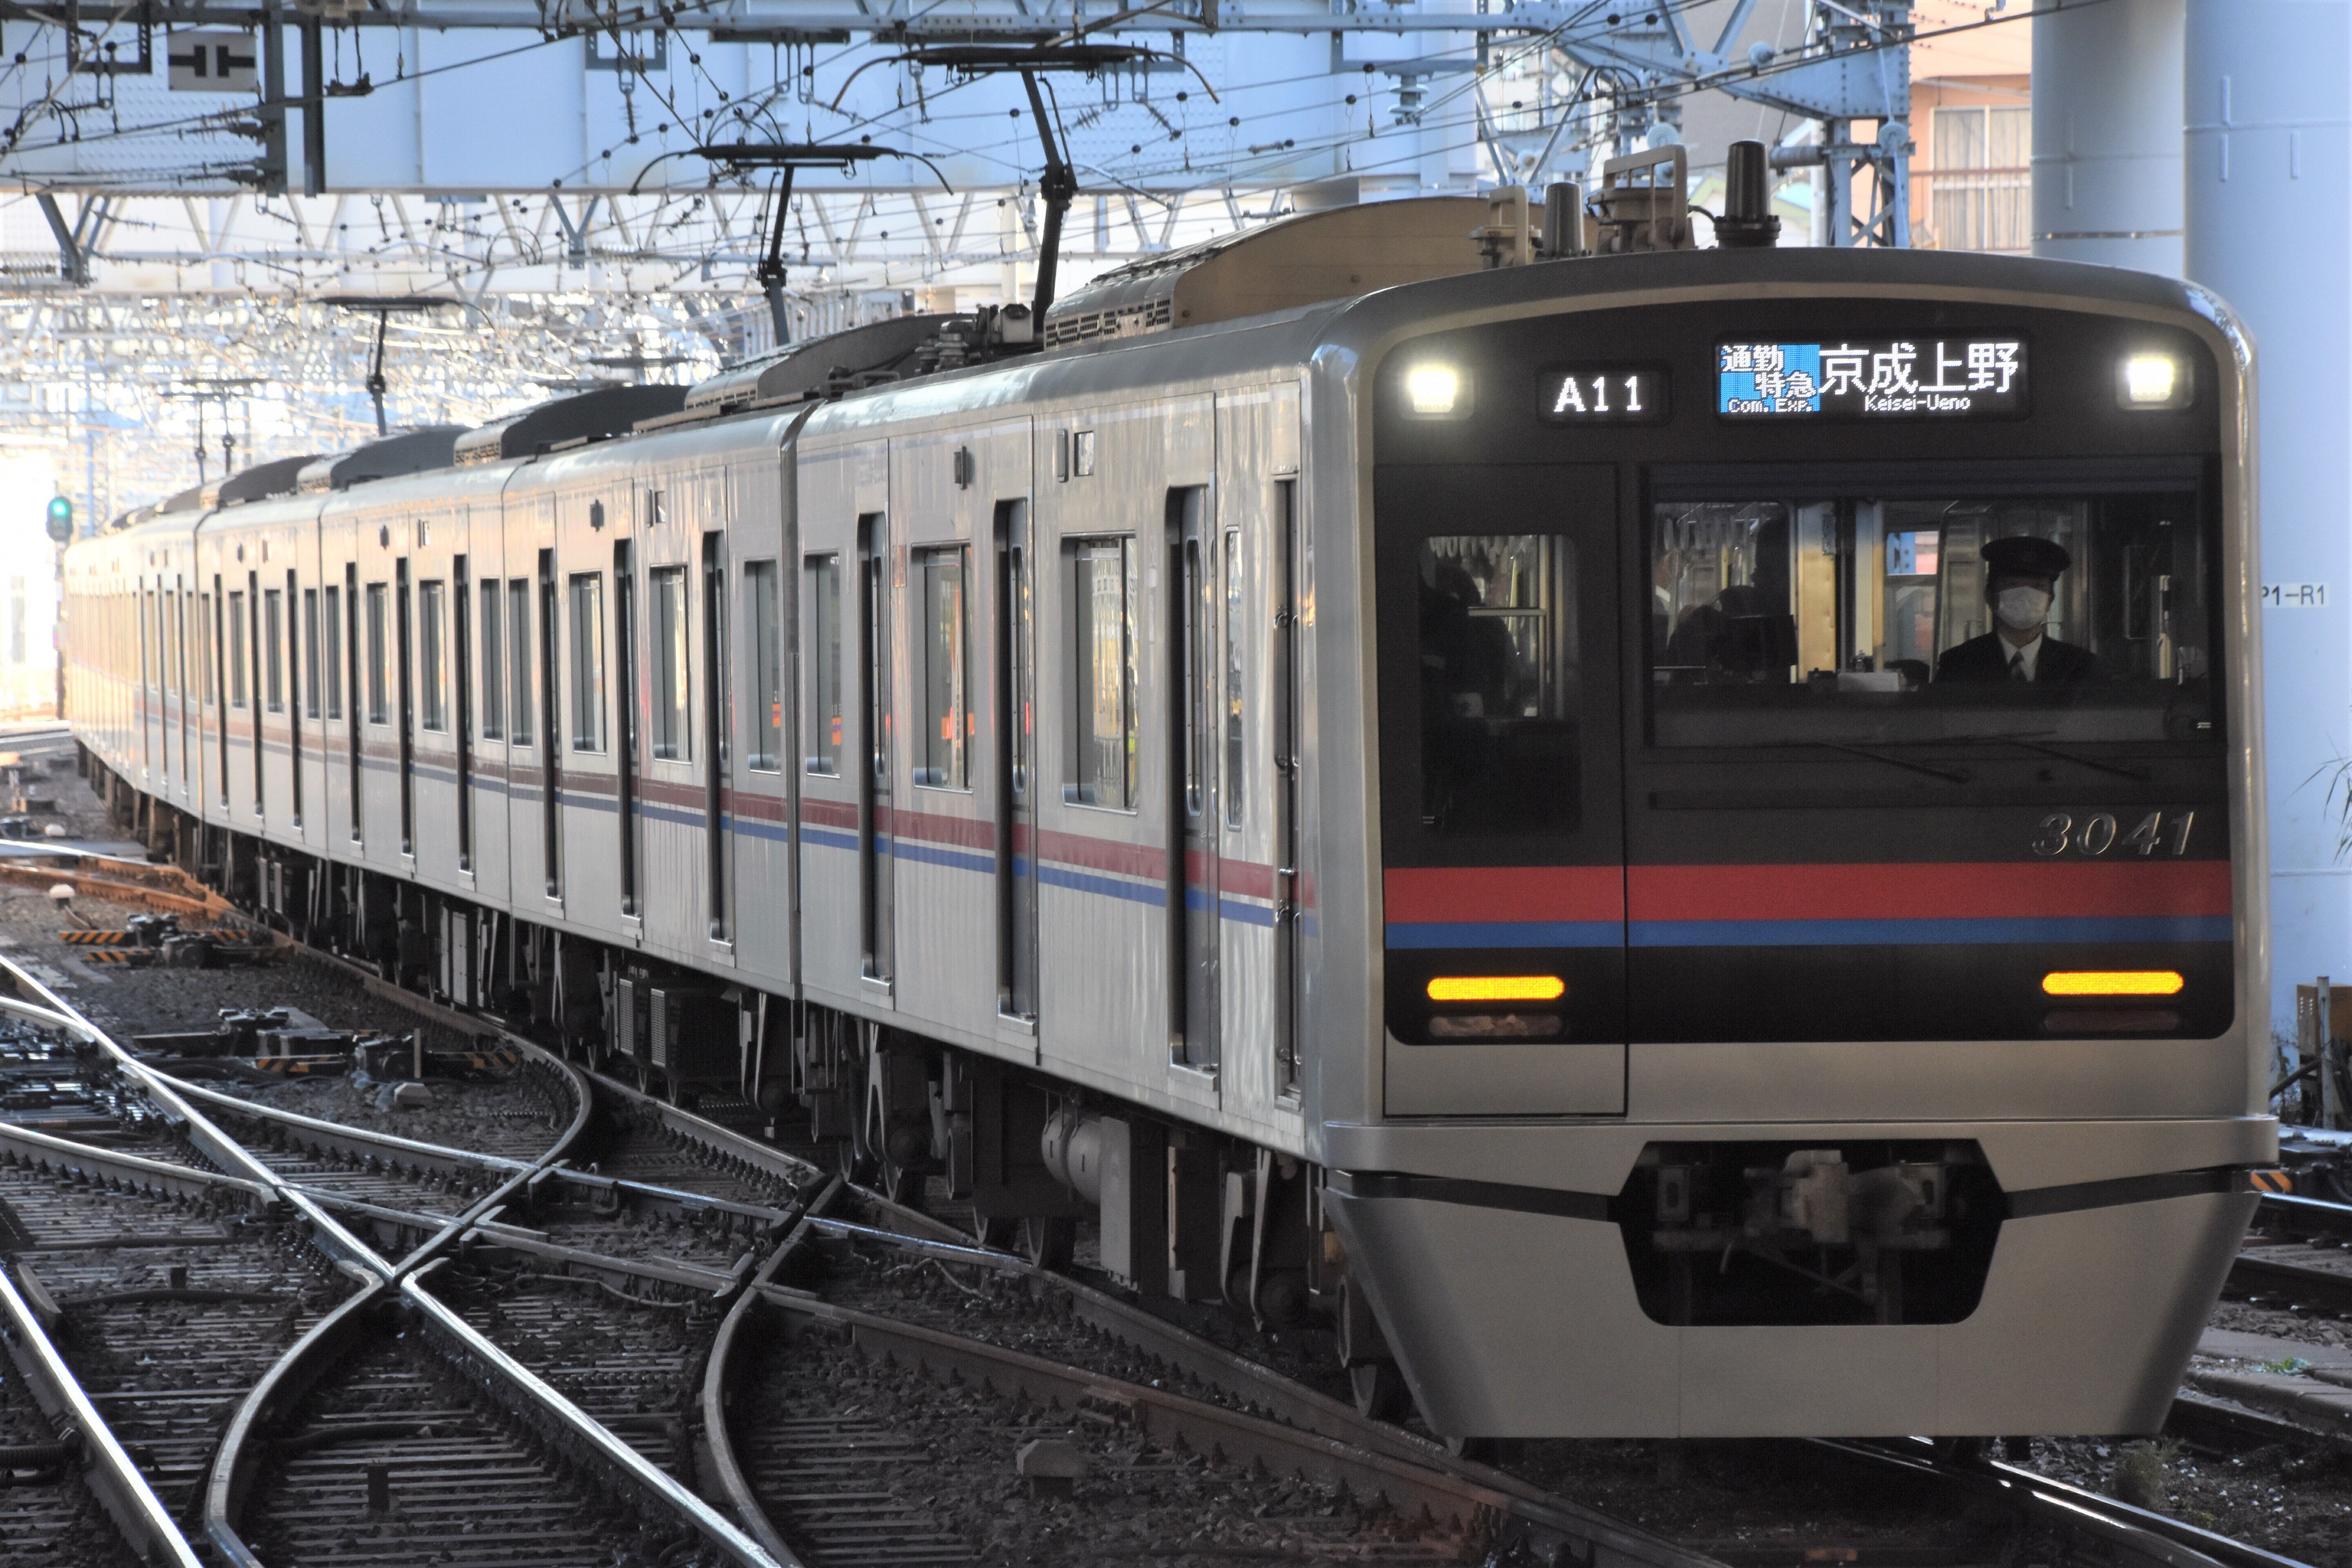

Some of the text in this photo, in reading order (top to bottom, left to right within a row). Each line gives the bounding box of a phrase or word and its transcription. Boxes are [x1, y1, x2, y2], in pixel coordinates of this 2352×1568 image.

[1722, 345, 1784, 372] 通勤
[1818, 342, 2019, 395] 京成上野
[1554, 375, 1641, 412] A11
[1755, 371, 1817, 398] 特急
[1728, 399, 1769, 413] Com.
[1864, 394, 1971, 412] Keisei-Ueno
[2032, 811, 2194, 855] 3041
